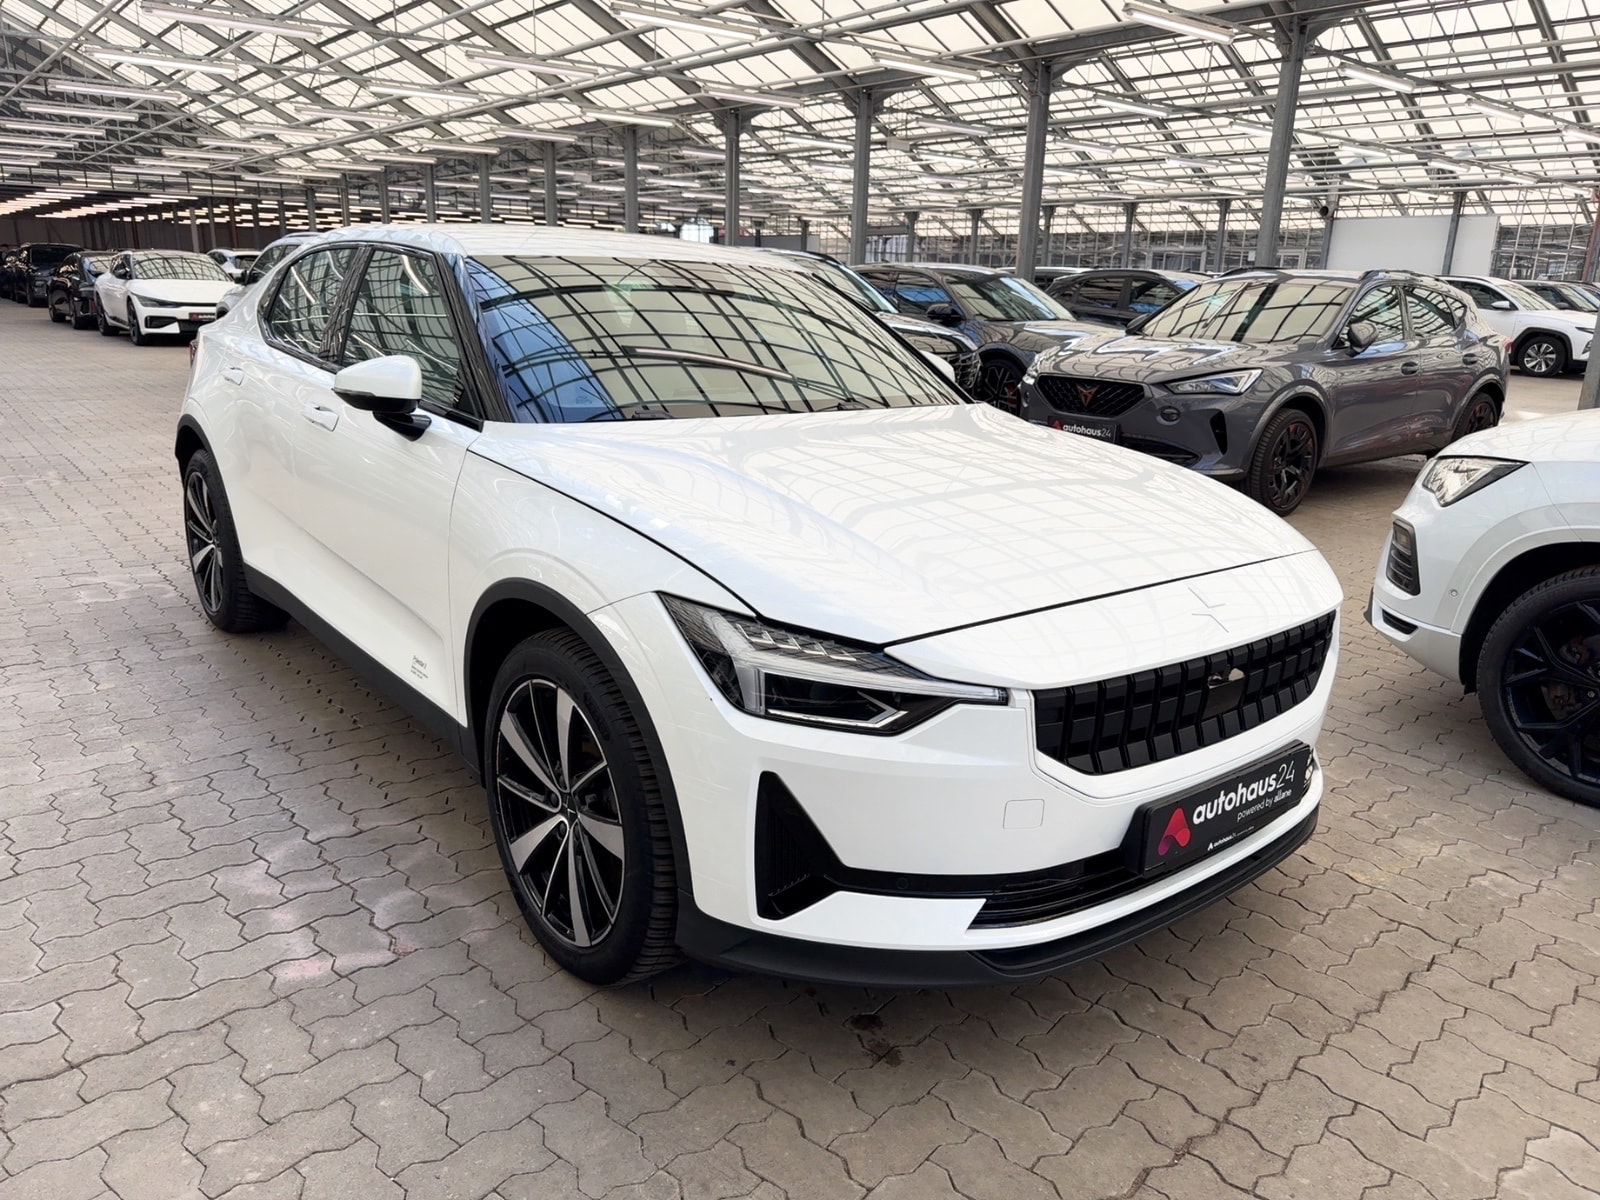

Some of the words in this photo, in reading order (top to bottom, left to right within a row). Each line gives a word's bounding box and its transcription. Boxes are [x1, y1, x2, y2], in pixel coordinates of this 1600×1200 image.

[1062, 424, 1111, 437] autohaus24
[1192, 760, 1295, 825] autohaus24
[1237, 799, 1265, 822] powered
[1265, 797, 1273, 807] by
[1274, 789, 1292, 803] allane
